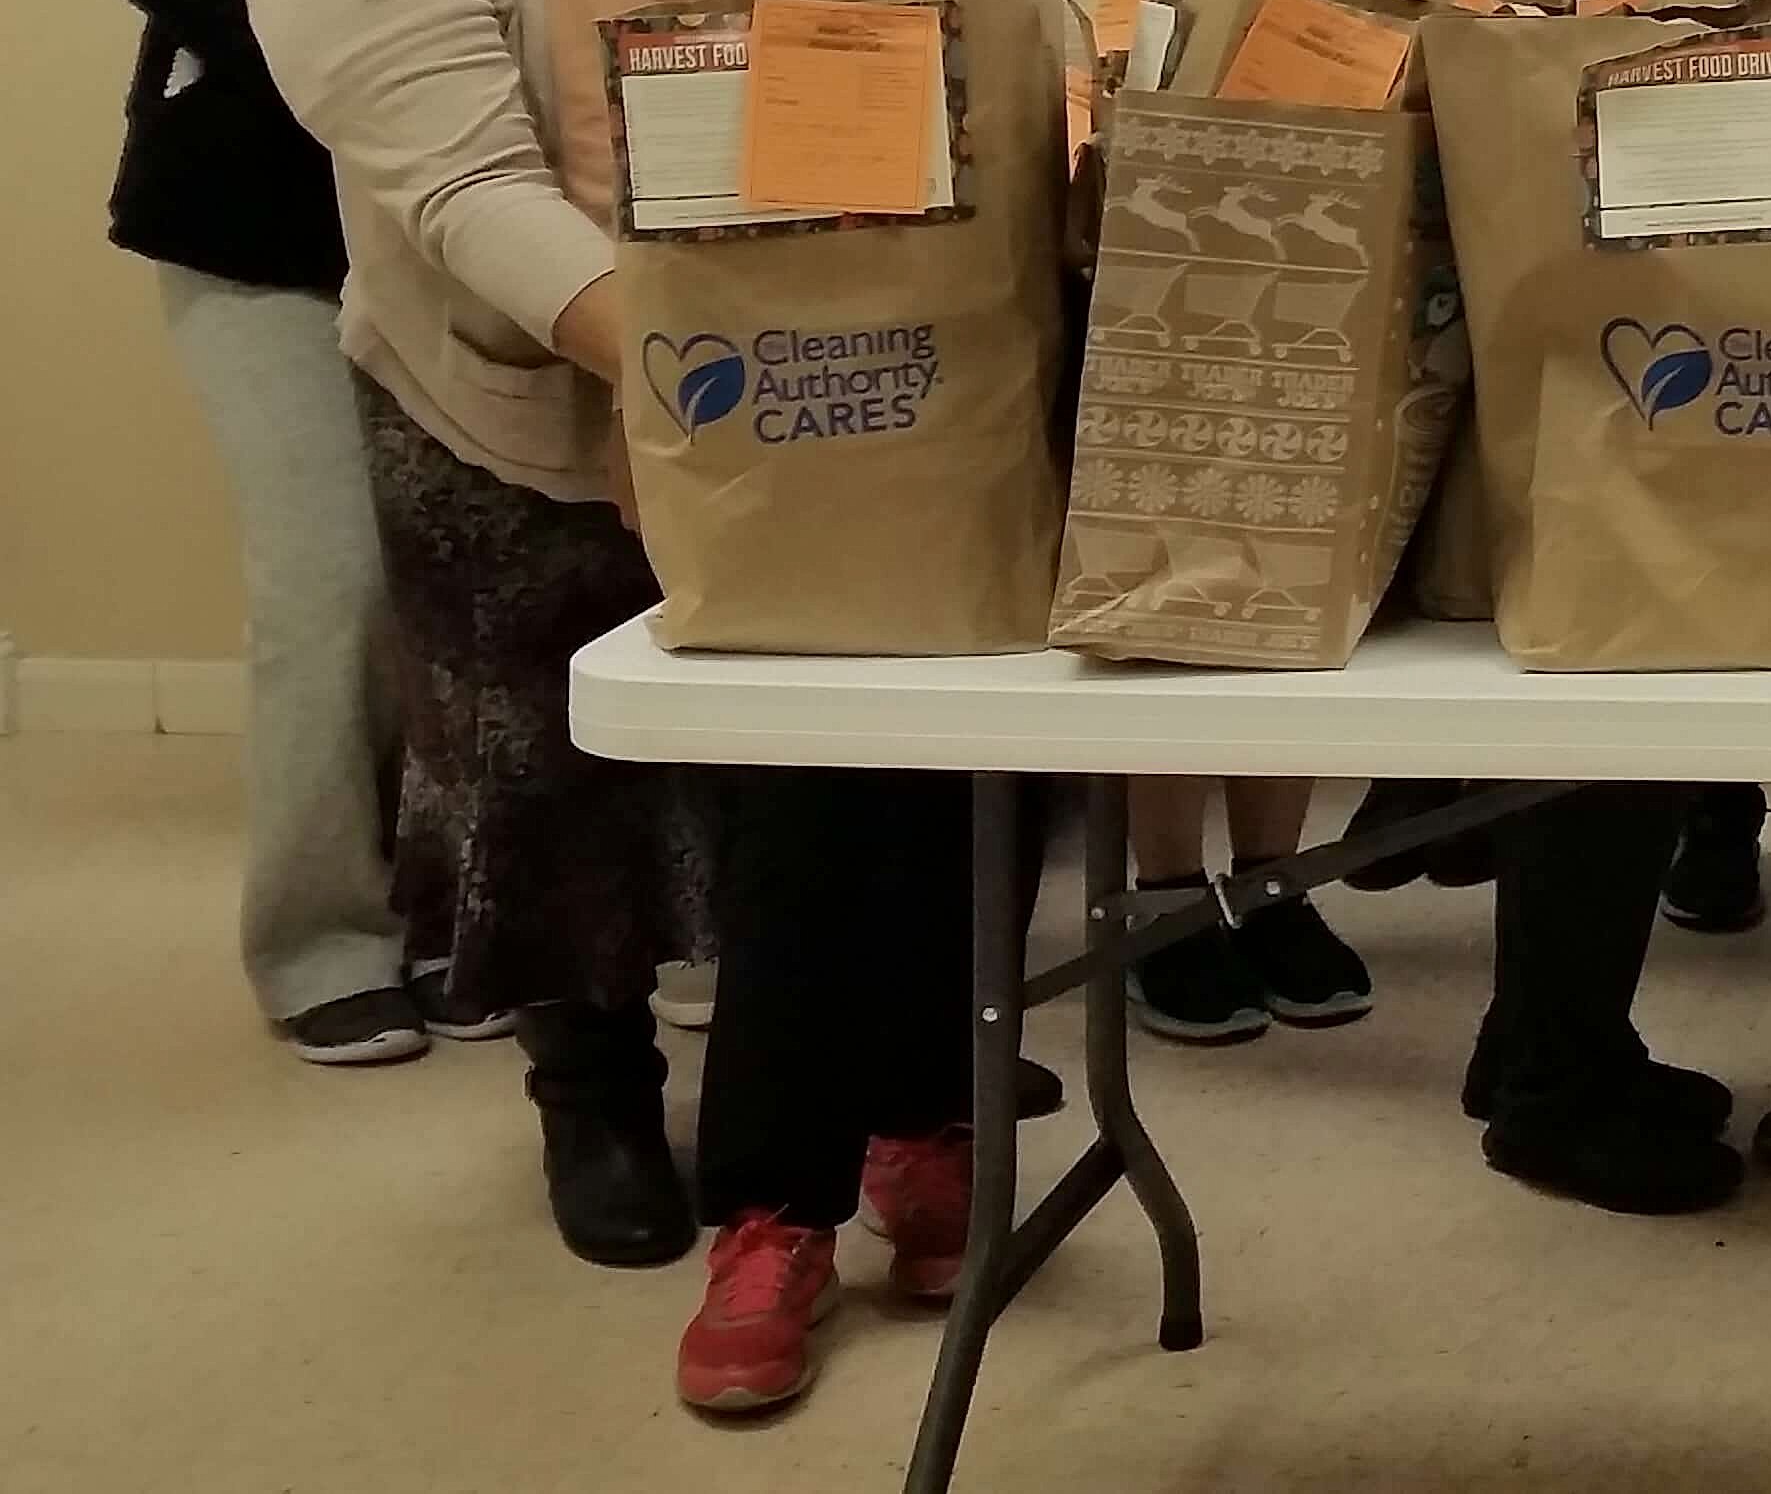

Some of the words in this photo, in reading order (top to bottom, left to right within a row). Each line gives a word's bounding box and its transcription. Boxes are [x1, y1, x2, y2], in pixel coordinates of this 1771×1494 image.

[628, 43, 707, 72] HARVEST
[712, 41, 749, 68] FOO
[1688, 53, 1733, 79] FOOD
[753, 322, 936, 368] Cleaning
[752, 357, 944, 404] Authority
[753, 394, 917, 446] CARES
